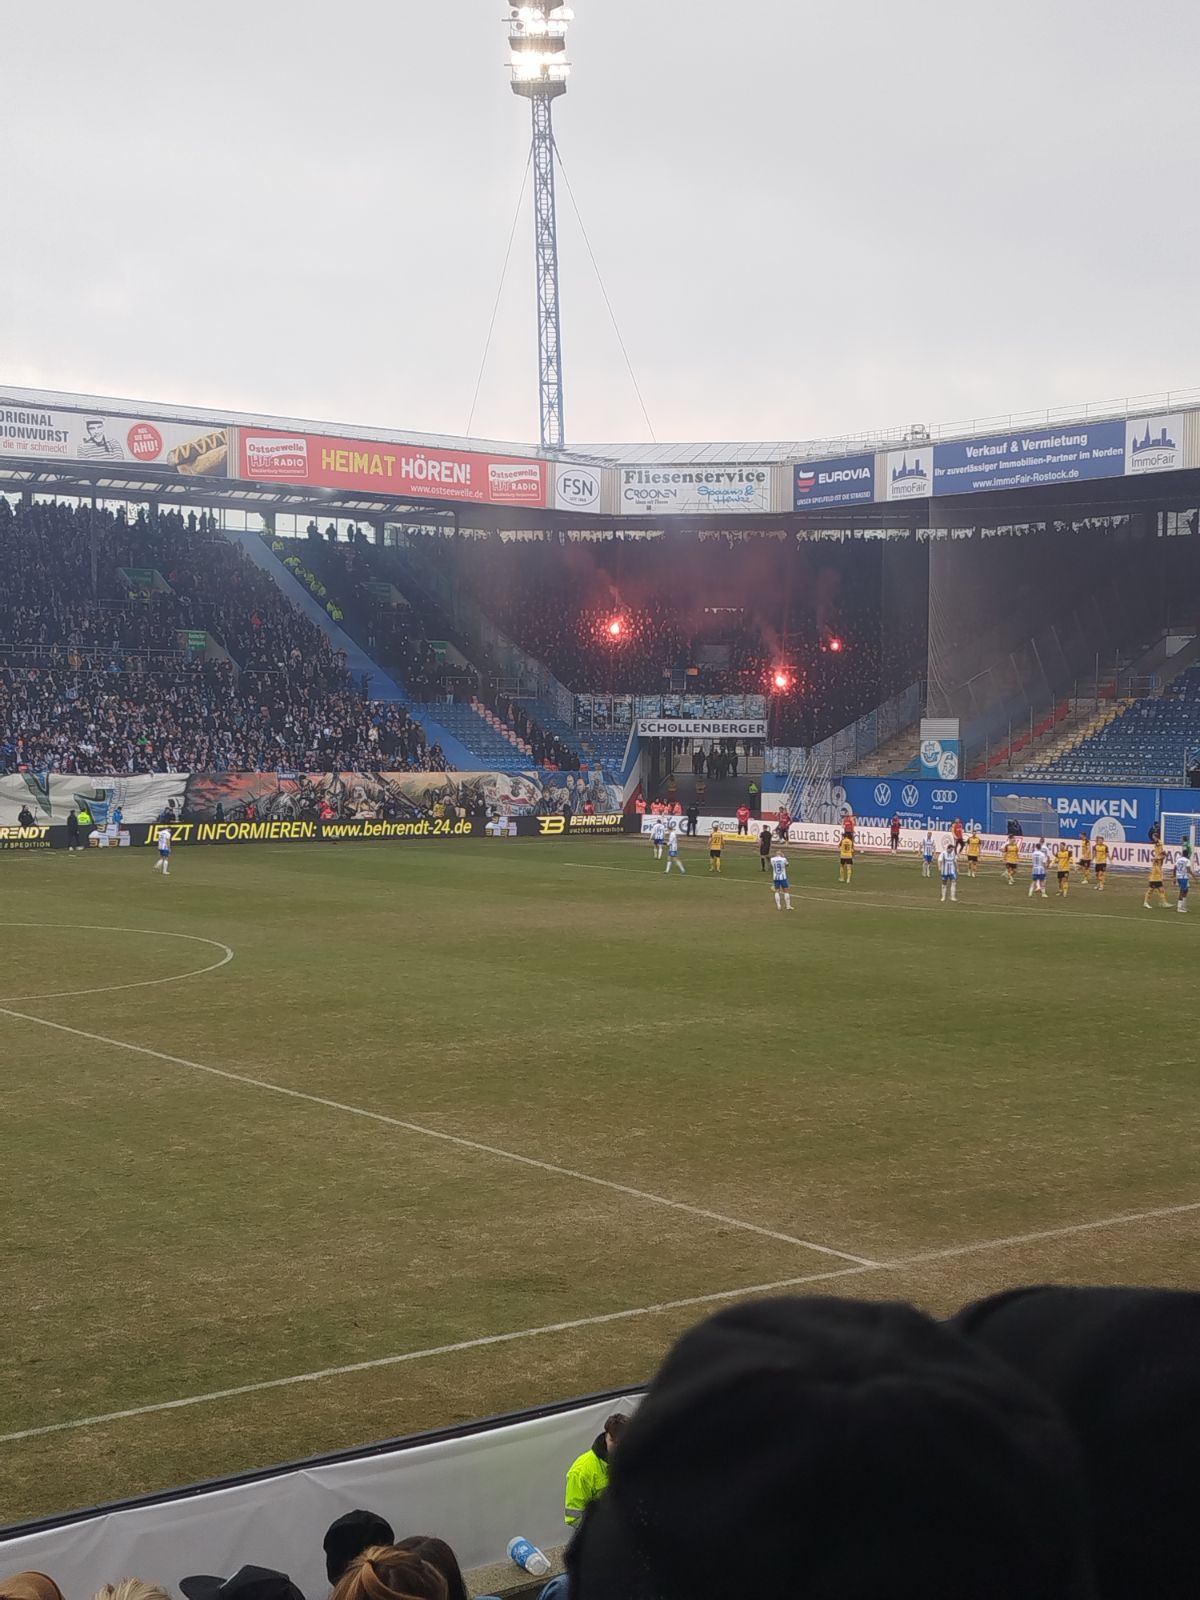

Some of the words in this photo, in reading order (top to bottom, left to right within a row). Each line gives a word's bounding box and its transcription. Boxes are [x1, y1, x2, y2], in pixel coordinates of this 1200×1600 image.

[133, 439, 159, 454] AHU!
[248, 443, 305, 453] Ostseewelle
[966, 443, 1007, 458] Verkauf
[1010, 440, 1019, 453] &
[1022, 434, 1088, 451] Vermietung
[321, 448, 396, 477] HEIMAT
[401, 454, 471, 485] HÖREN!
[934, 467, 945, 476] Ihr
[947, 462, 997, 476] zuverlässiger
[999, 452, 1078, 469] Immobilien-Partner
[1079, 449, 1090, 460] im
[1092, 446, 1124, 458] Norden
[1131, 453, 1176, 468] ImmoFair
[490, 469, 538, 479] Ostseewelle
[623, 469, 766, 485] Fliesenservice
[818, 467, 871, 484] EUROVIA
[972, 468, 1080, 489] www.ImmoFair-Rostock.de
[410, 484, 484, 499] www.ostseewelle.de
[563, 477, 593, 497] FSN
[624, 487, 677, 501] CROONEN
[891, 481, 927, 495] ImmoFair
[640, 722, 765, 734] SCHOLLENBERGER
[570, 815, 624, 826] BEHRENDT
[1059, 818, 1078, 829] MV
[197, 821, 318, 841] INFORMIEREN:
[321, 818, 472, 837] www.behrendt-24.de
[1112, 847, 1135, 862] AUF
